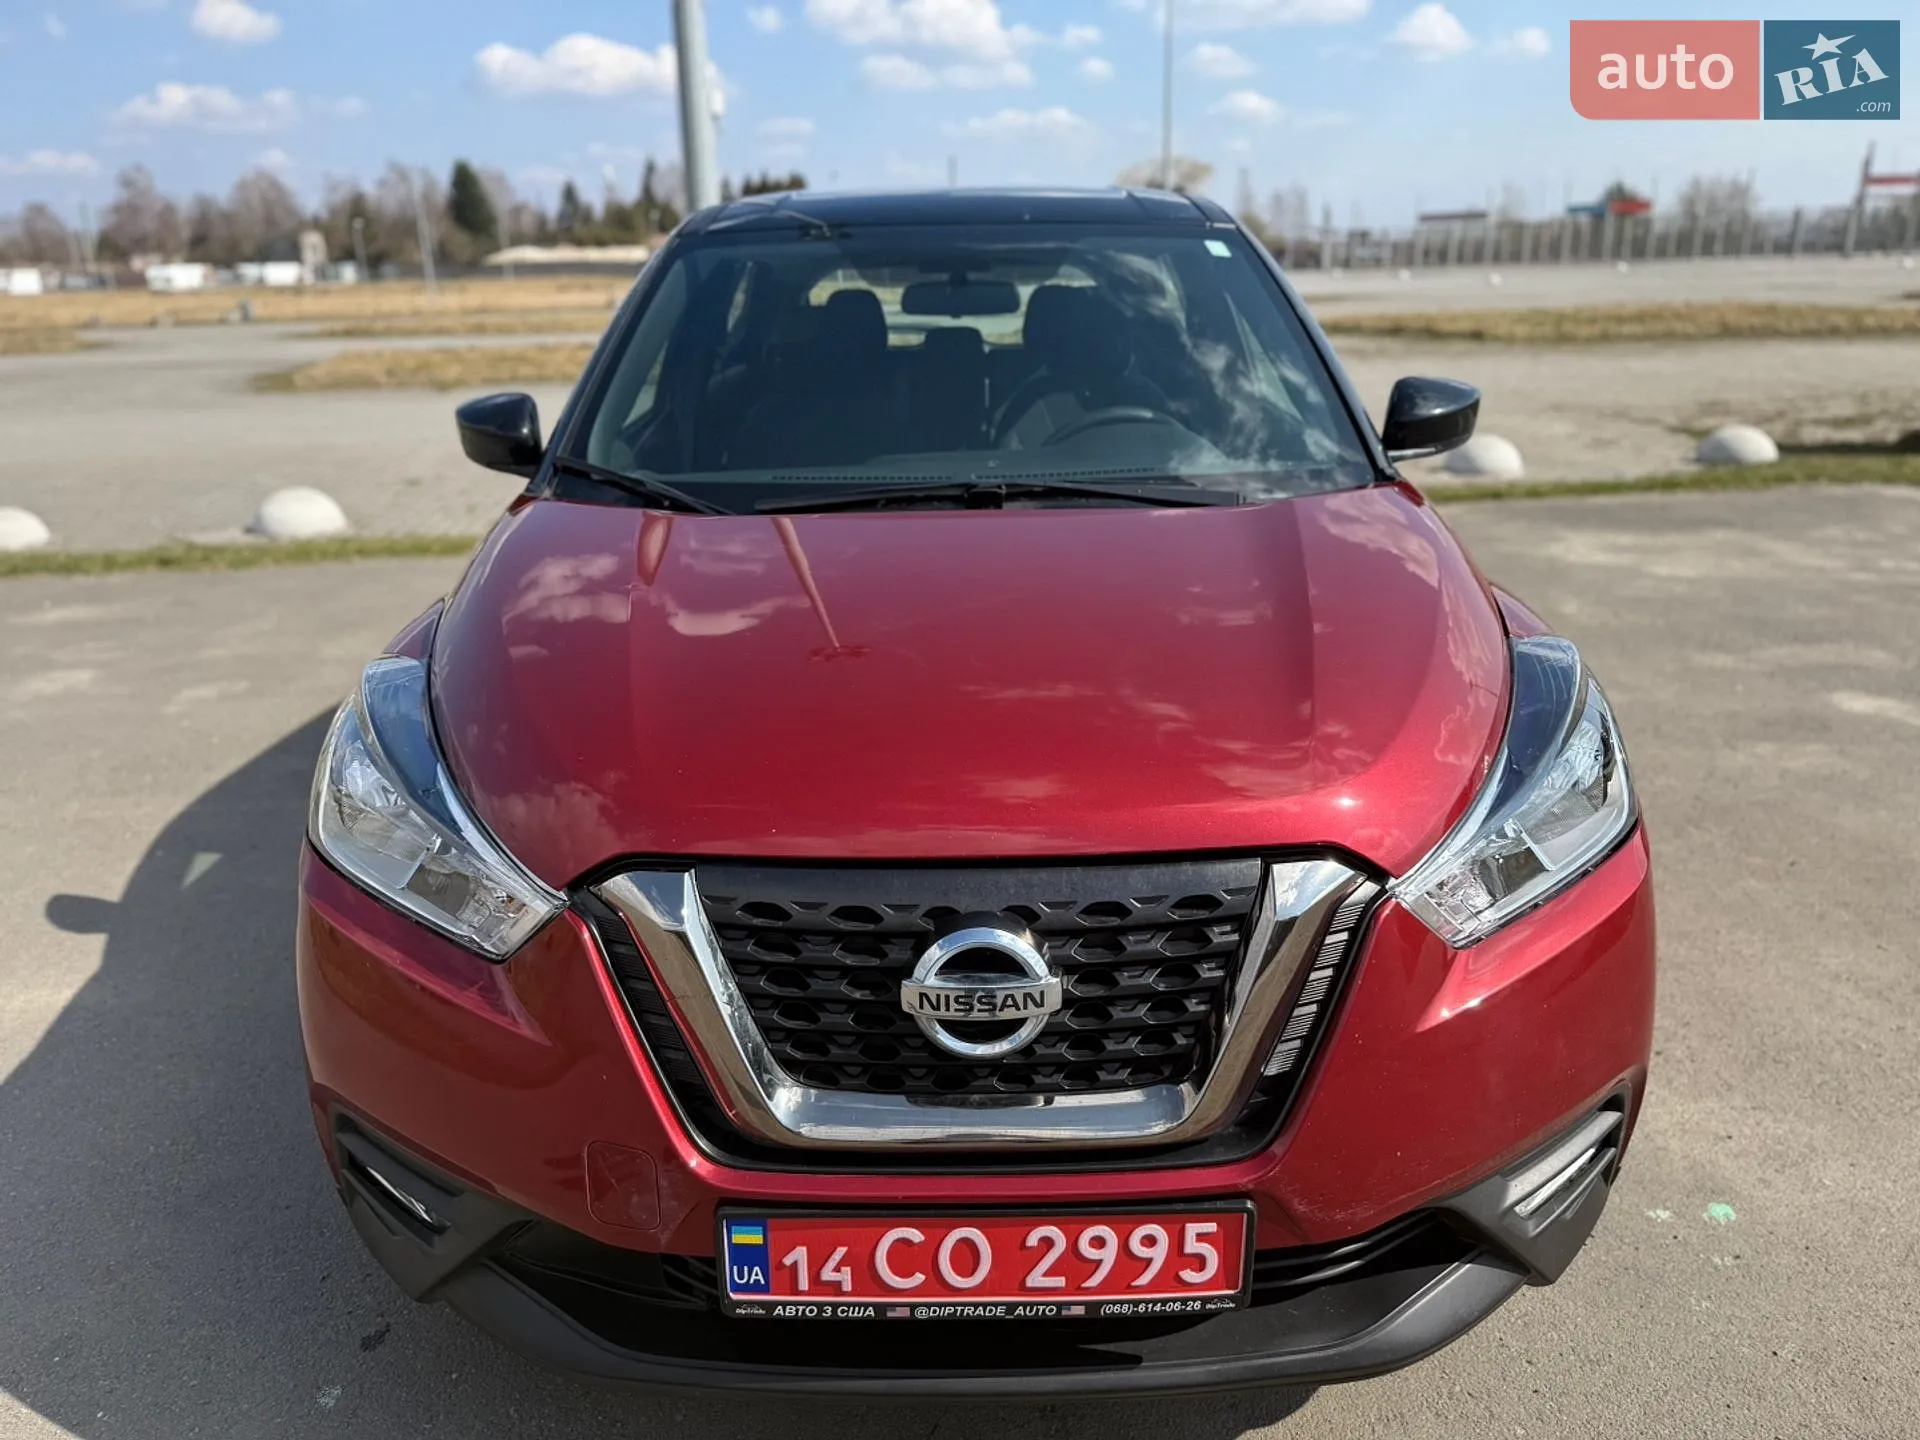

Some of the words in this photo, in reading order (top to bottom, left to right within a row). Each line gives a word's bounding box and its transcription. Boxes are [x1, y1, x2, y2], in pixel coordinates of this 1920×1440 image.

[918, 989, 1046, 1013] NISSAN
[781, 1245, 853, 1292] 14
[874, 1226, 993, 1290] CO
[1024, 1222, 1220, 1289] 2995
[733, 1265, 765, 1285] UA
[772, 1305, 818, 1317] АВТО
[836, 1306, 876, 1318] США
[914, 1304, 1057, 1319] @DIPTRADE_AUTO
[1100, 1300, 1202, 1316] (068)-614-06-26
